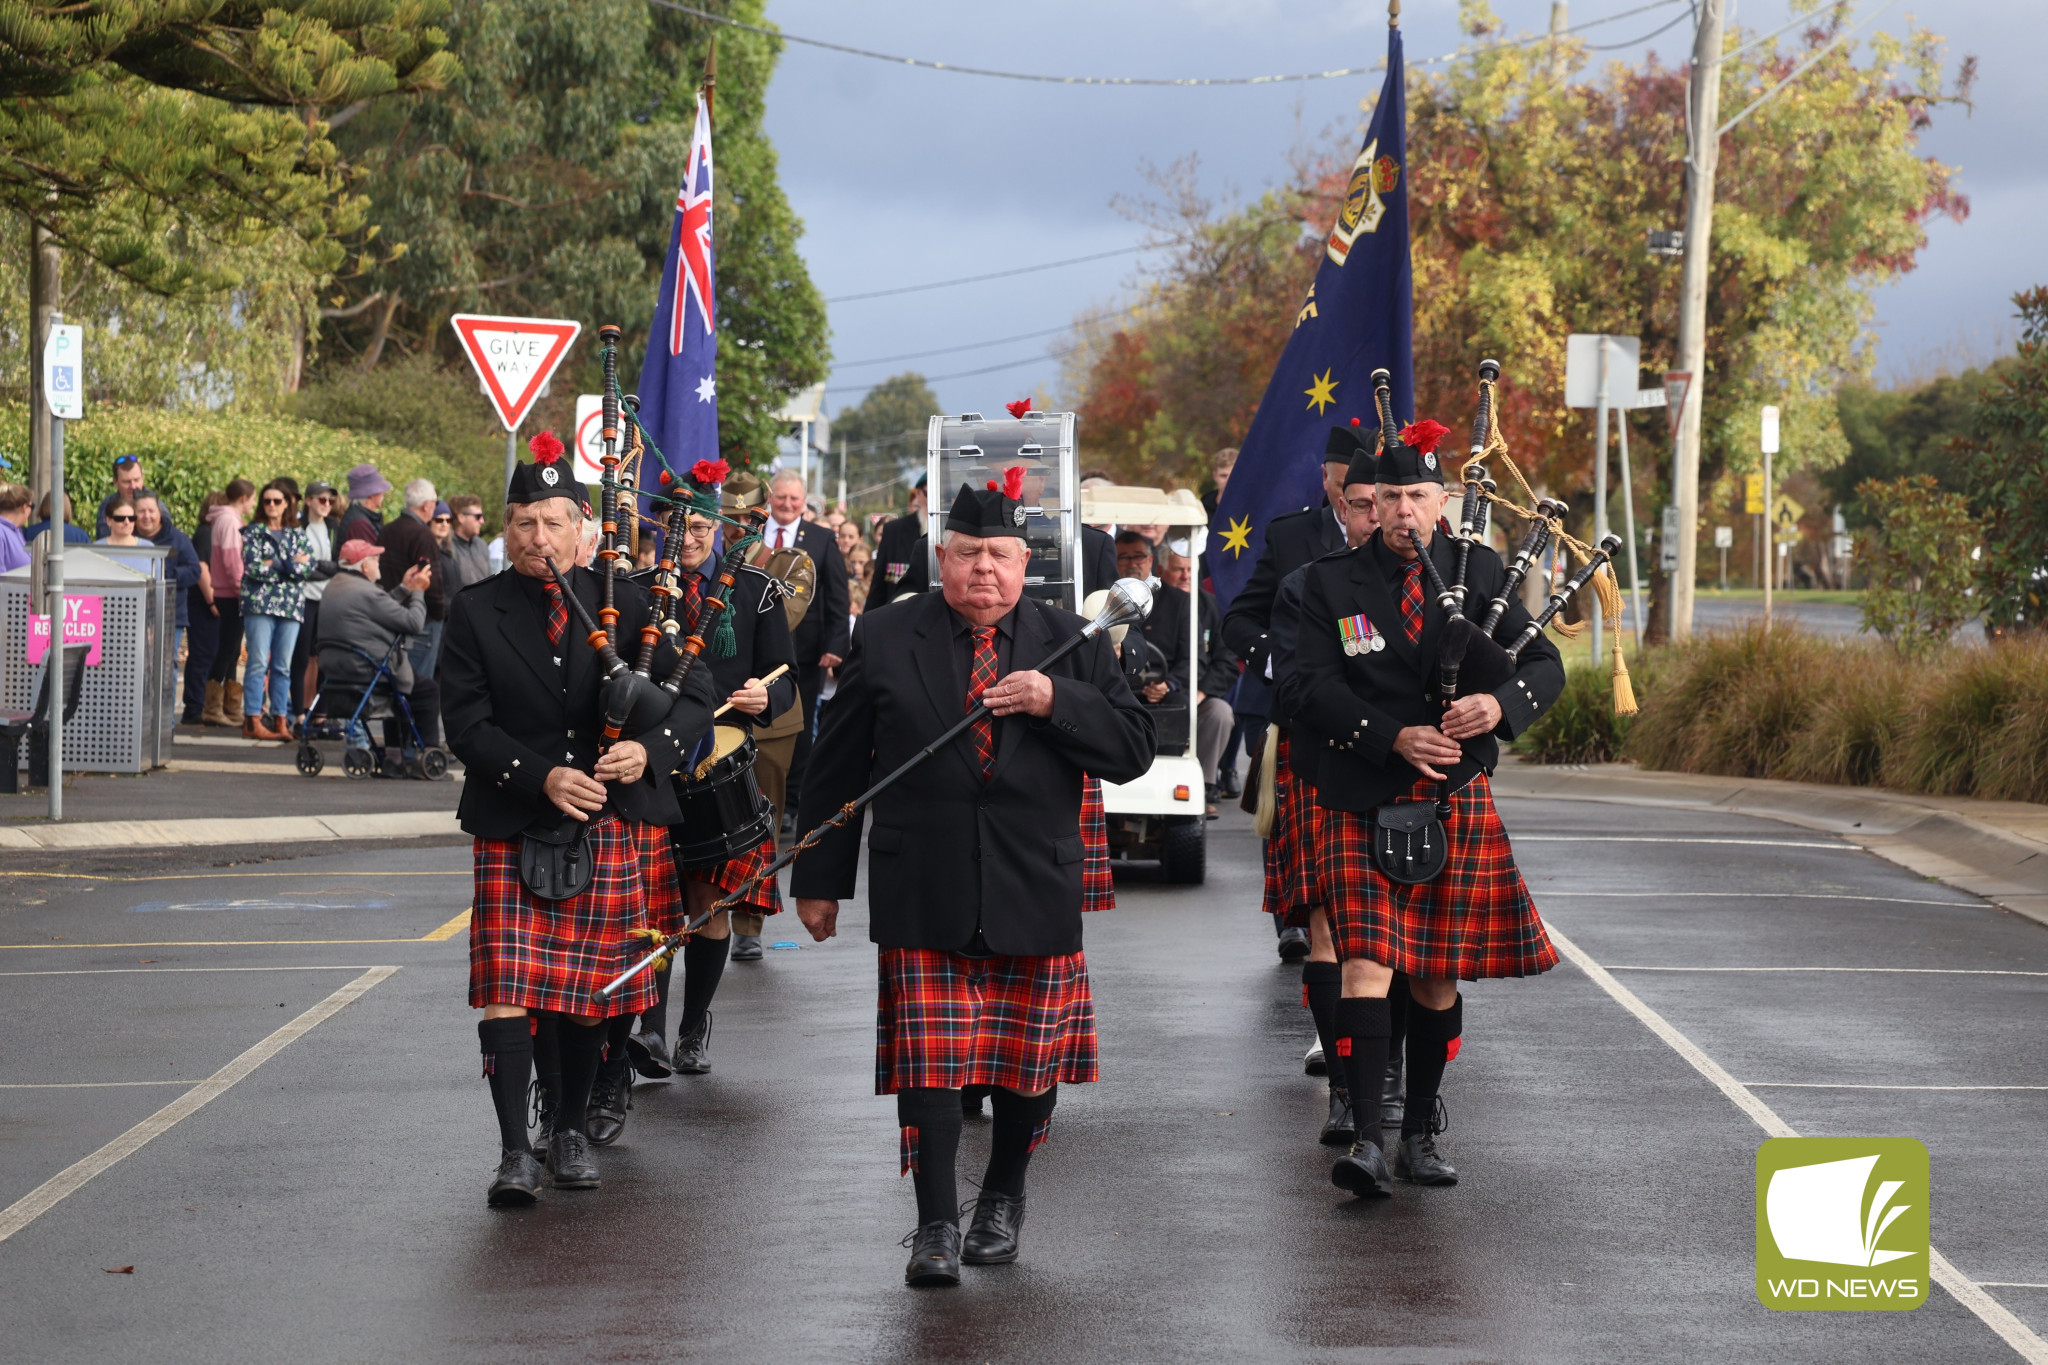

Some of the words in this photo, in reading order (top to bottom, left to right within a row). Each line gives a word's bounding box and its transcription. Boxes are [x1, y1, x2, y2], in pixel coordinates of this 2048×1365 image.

[56, 336, 70, 357] P
[490, 339, 540, 357] GIVE
[497, 361, 531, 373] WAY
[34, 621, 96, 637] RECLED
